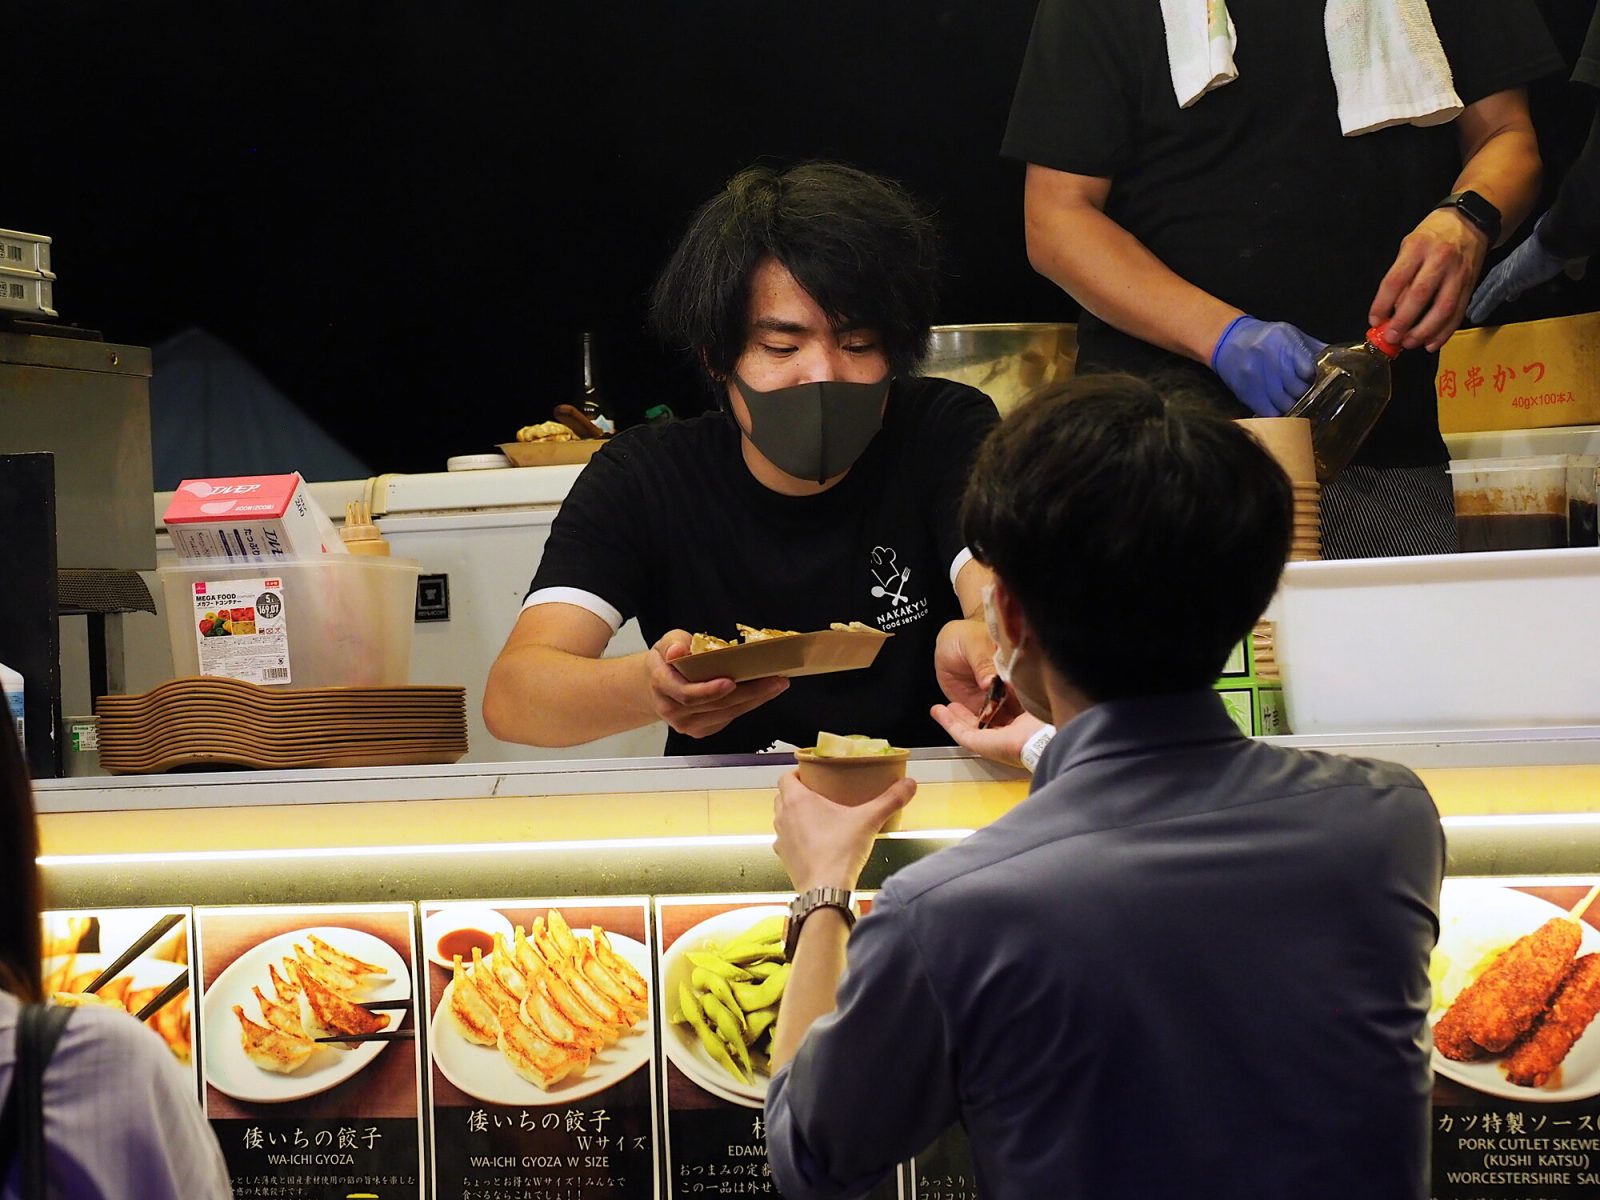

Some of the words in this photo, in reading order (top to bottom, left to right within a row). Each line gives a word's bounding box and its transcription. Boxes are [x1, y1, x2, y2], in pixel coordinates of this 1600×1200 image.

[1438, 362, 1546, 398] 肉串かつ
[195, 594, 216, 602] MEGA
[876, 597, 928, 625] NAKAKYU
[882, 619, 901, 631] food
[901, 608, 928, 624] service
[466, 1109, 611, 1133] 倭いちの餃子
[243, 1126, 382, 1150] 倭いちの餃子
[577, 1135, 648, 1151] Wサイズ
[1458, 1138, 1497, 1150] PORK
[1498, 1138, 1550, 1150] CUTLET
[267, 1154, 312, 1165] WA-ICHI
[315, 1154, 354, 1165] GYOZA
[521, 1156, 562, 1167] GYOZA
[566, 1156, 580, 1167] W
[584, 1156, 610, 1167] SIZE
[1483, 1154, 1532, 1170] (KUSHI
[1538, 1154, 1590, 1170] KATSU)
[1446, 1172, 1571, 1184] WORCESTERSHIRE
